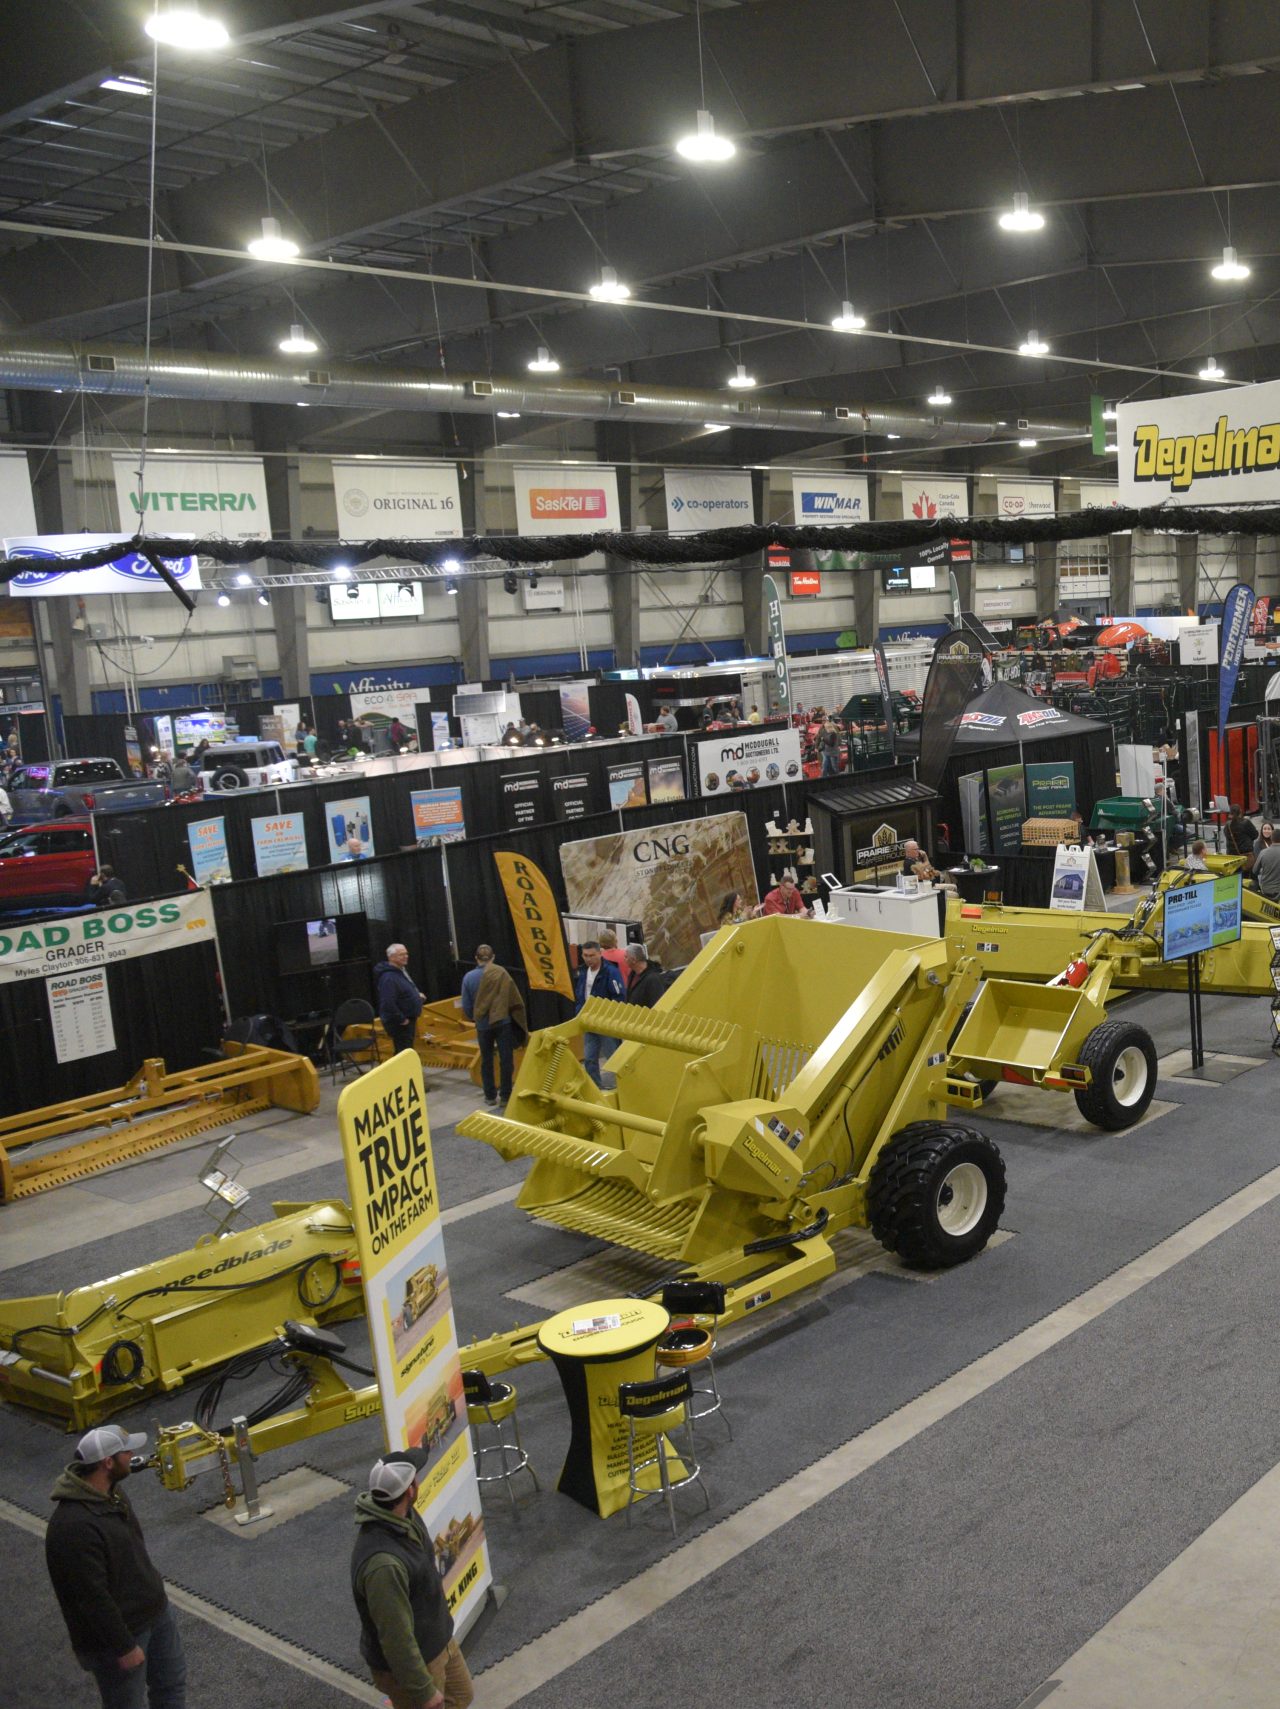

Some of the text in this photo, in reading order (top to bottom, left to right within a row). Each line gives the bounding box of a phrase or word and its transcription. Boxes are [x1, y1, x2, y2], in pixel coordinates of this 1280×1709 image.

[129, 491, 257, 512] VITERRA
[373, 497, 454, 510] ORIGINAL 16
[536, 496, 583, 511] SaskTel
[687, 498, 749, 513] co-operators
[814, 496, 861, 510] WINMAR
[932, 542, 950, 556] Locally
[1221, 588, 1249, 670] PERFORMER
[1016, 708, 1060, 726] AMSOIL
[745, 738, 780, 749] MCDOUGALL
[198, 825, 218, 836] SAVE
[264, 820, 293, 832] SAVE
[634, 835, 690, 863] CNG
[858, 846, 890, 860] PRAIRIE
[1168, 890, 1197, 905] PRO-TILL
[83, 903, 181, 940] BOSS
[514, 860, 555, 985] ROAD BOSS
[972, 925, 1009, 934] Degelman
[45, 941, 105, 962] GRADER
[15, 968, 41, 978] Myles
[41, 959, 74, 974] Clayton
[108, 948, 127, 960] 9043
[51, 973, 103, 991] ROAD BOSS
[354, 1078, 420, 1146] MAKE A
[359, 1108, 426, 1196] TRUE
[743, 1135, 781, 1177] Degelman
[366, 1157, 429, 1235] IMPACT
[371, 1190, 434, 1256] ON THE FARM
[626, 1383, 688, 1406] Degelman
[458, 1562, 478, 1597] KING
